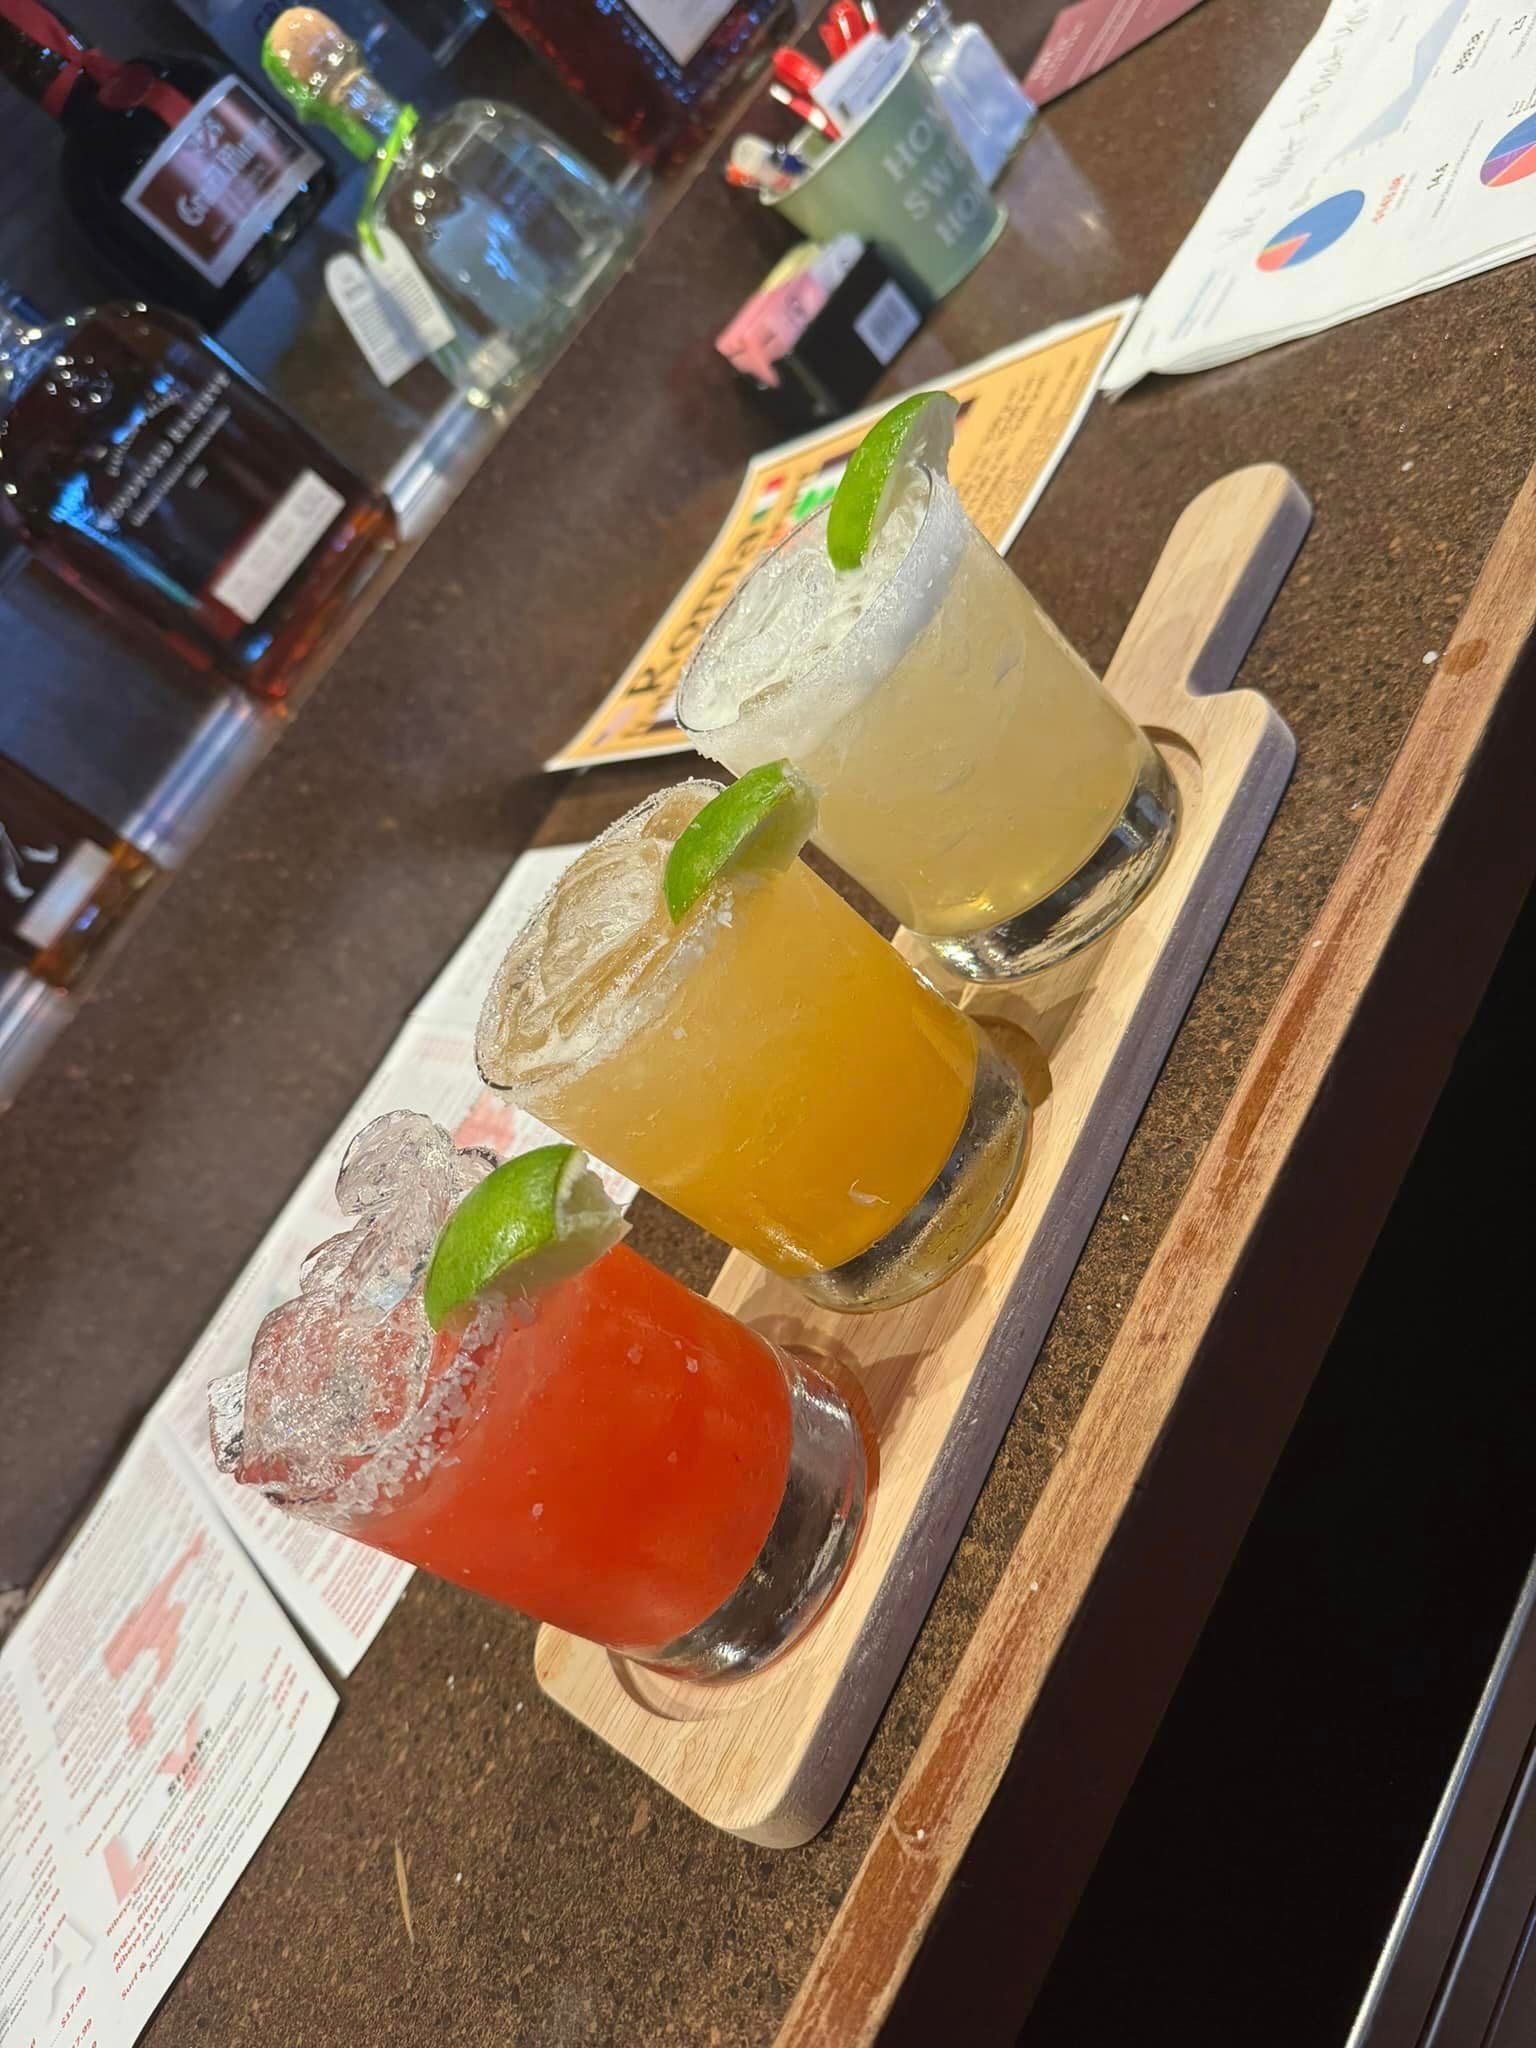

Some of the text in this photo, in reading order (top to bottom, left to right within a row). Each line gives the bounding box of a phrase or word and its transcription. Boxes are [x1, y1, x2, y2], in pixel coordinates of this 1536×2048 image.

[880, 106, 940, 182] HO
[167, 1728, 211, 1797] Steaks
[112, 1924, 137, 1963] Angus
[137, 1884, 164, 1925] Ribeye
[114, 1930, 143, 1975] Ribeye
[120, 1932, 166, 2001] Surf & Turf
[60, 1985, 86, 2029] $17.99
[71, 2017, 92, 2048] 7.99
